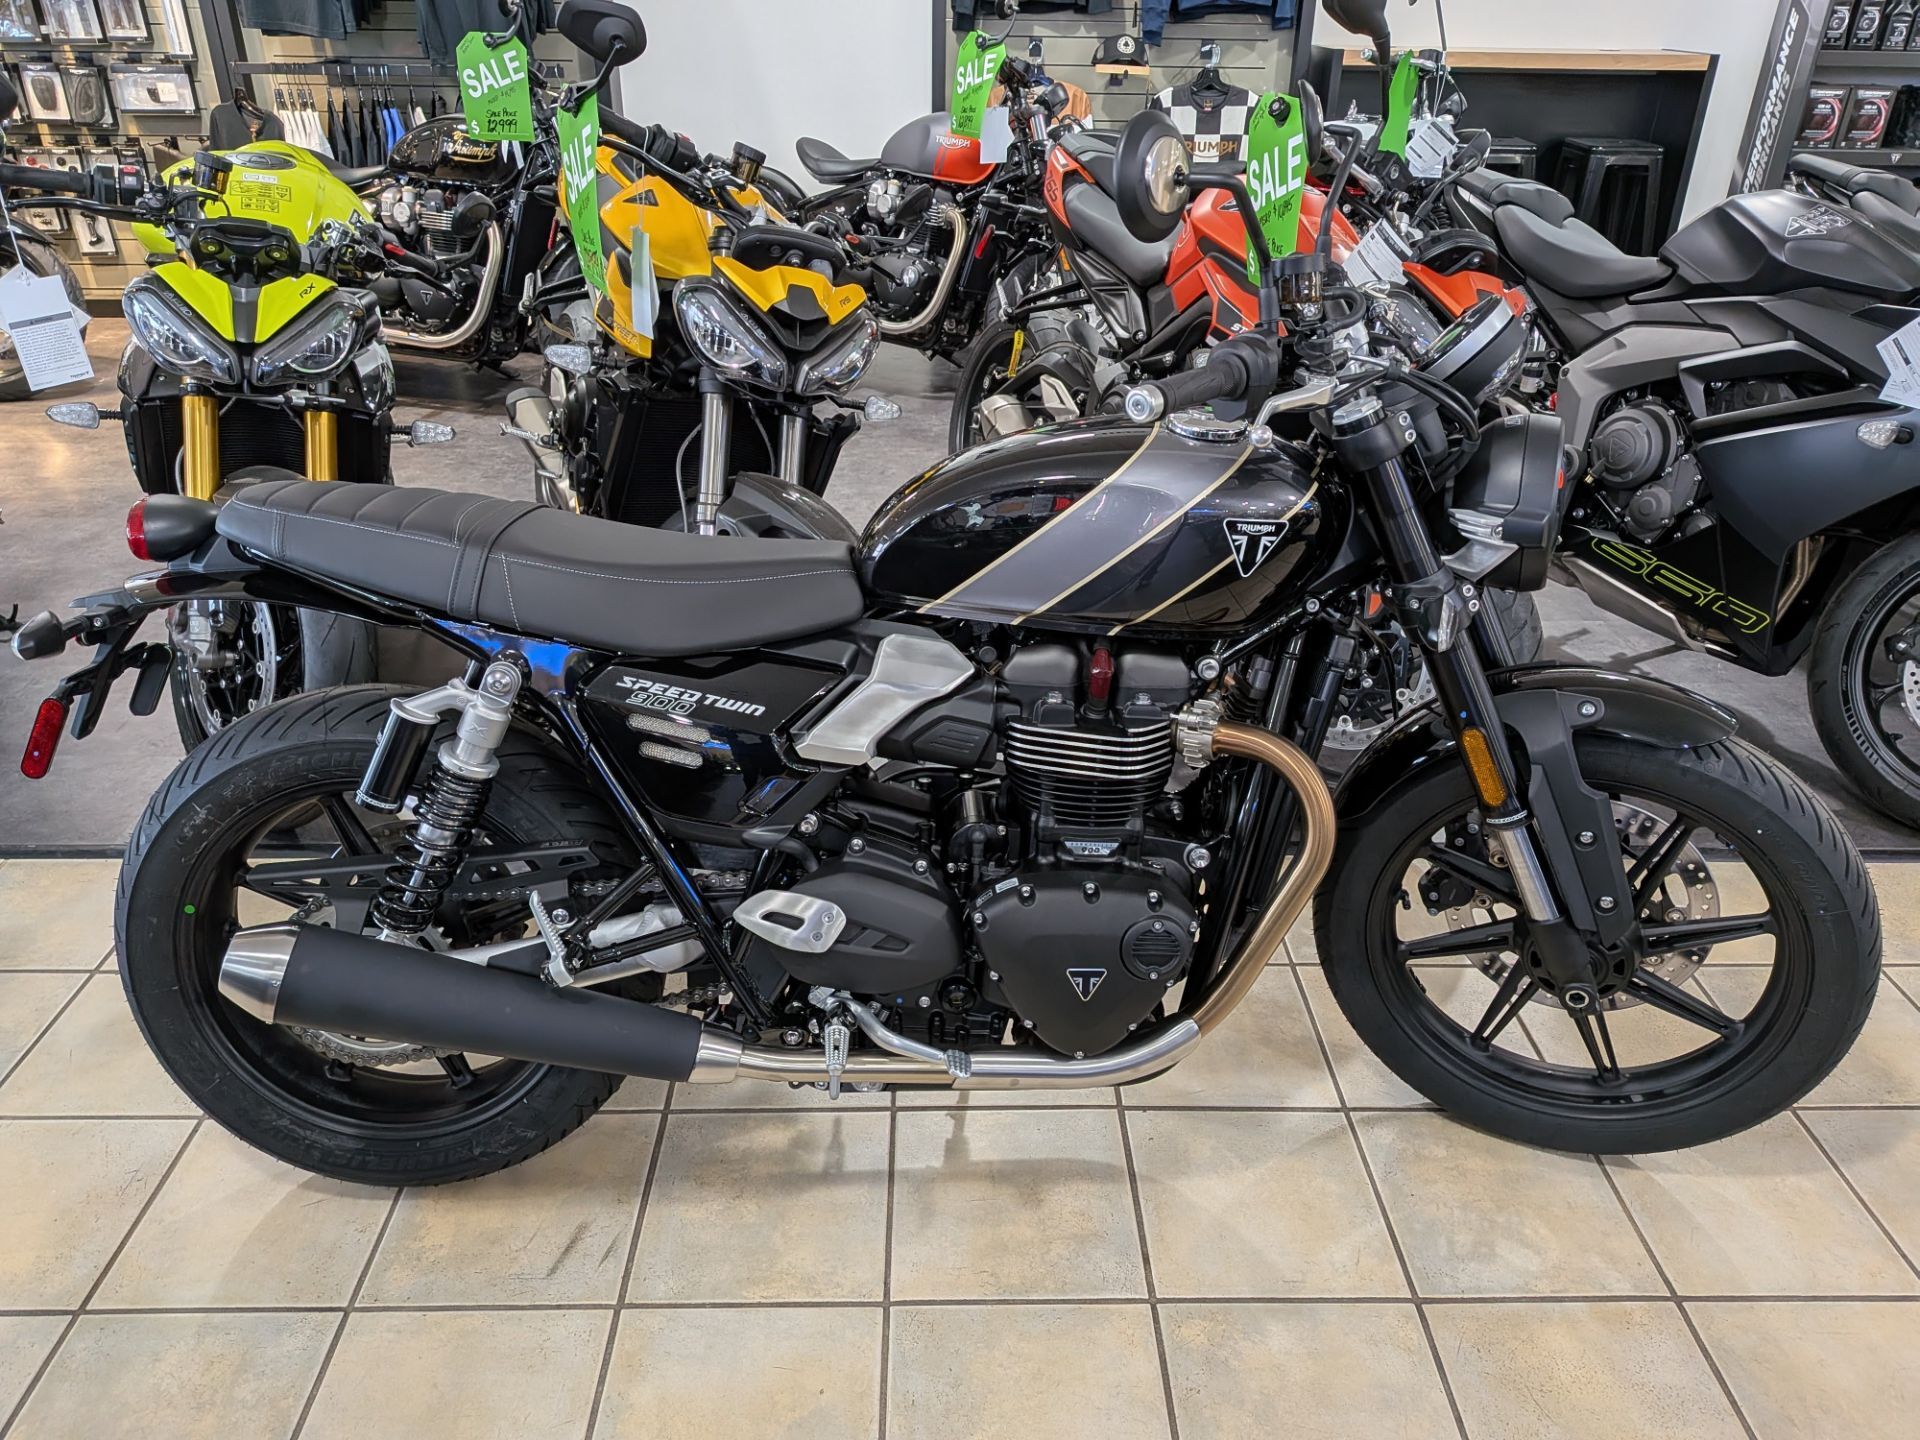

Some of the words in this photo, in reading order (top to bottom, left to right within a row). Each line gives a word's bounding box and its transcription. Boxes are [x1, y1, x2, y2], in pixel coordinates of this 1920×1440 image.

[463, 50, 525, 98] SALE
[957, 54, 998, 94] SALE
[1743, 7, 1799, 194] PERFORMANCE
[472, 120, 480, 135] $
[936, 136, 971, 149] TRIUMPH
[1752, 70, 1790, 193] UBRICANTS
[1184, 140, 1239, 153] RIUMPH
[563, 123, 594, 204] SALE
[1250, 133, 1303, 211] SALE
[299, 282, 316, 298] RX
[839, 296, 852, 308] RS
[1236, 523, 1276, 535] TRIUMPH
[616, 675, 702, 701] SPEED
[703, 694, 767, 716] TWIN
[625, 690, 697, 715] 900
